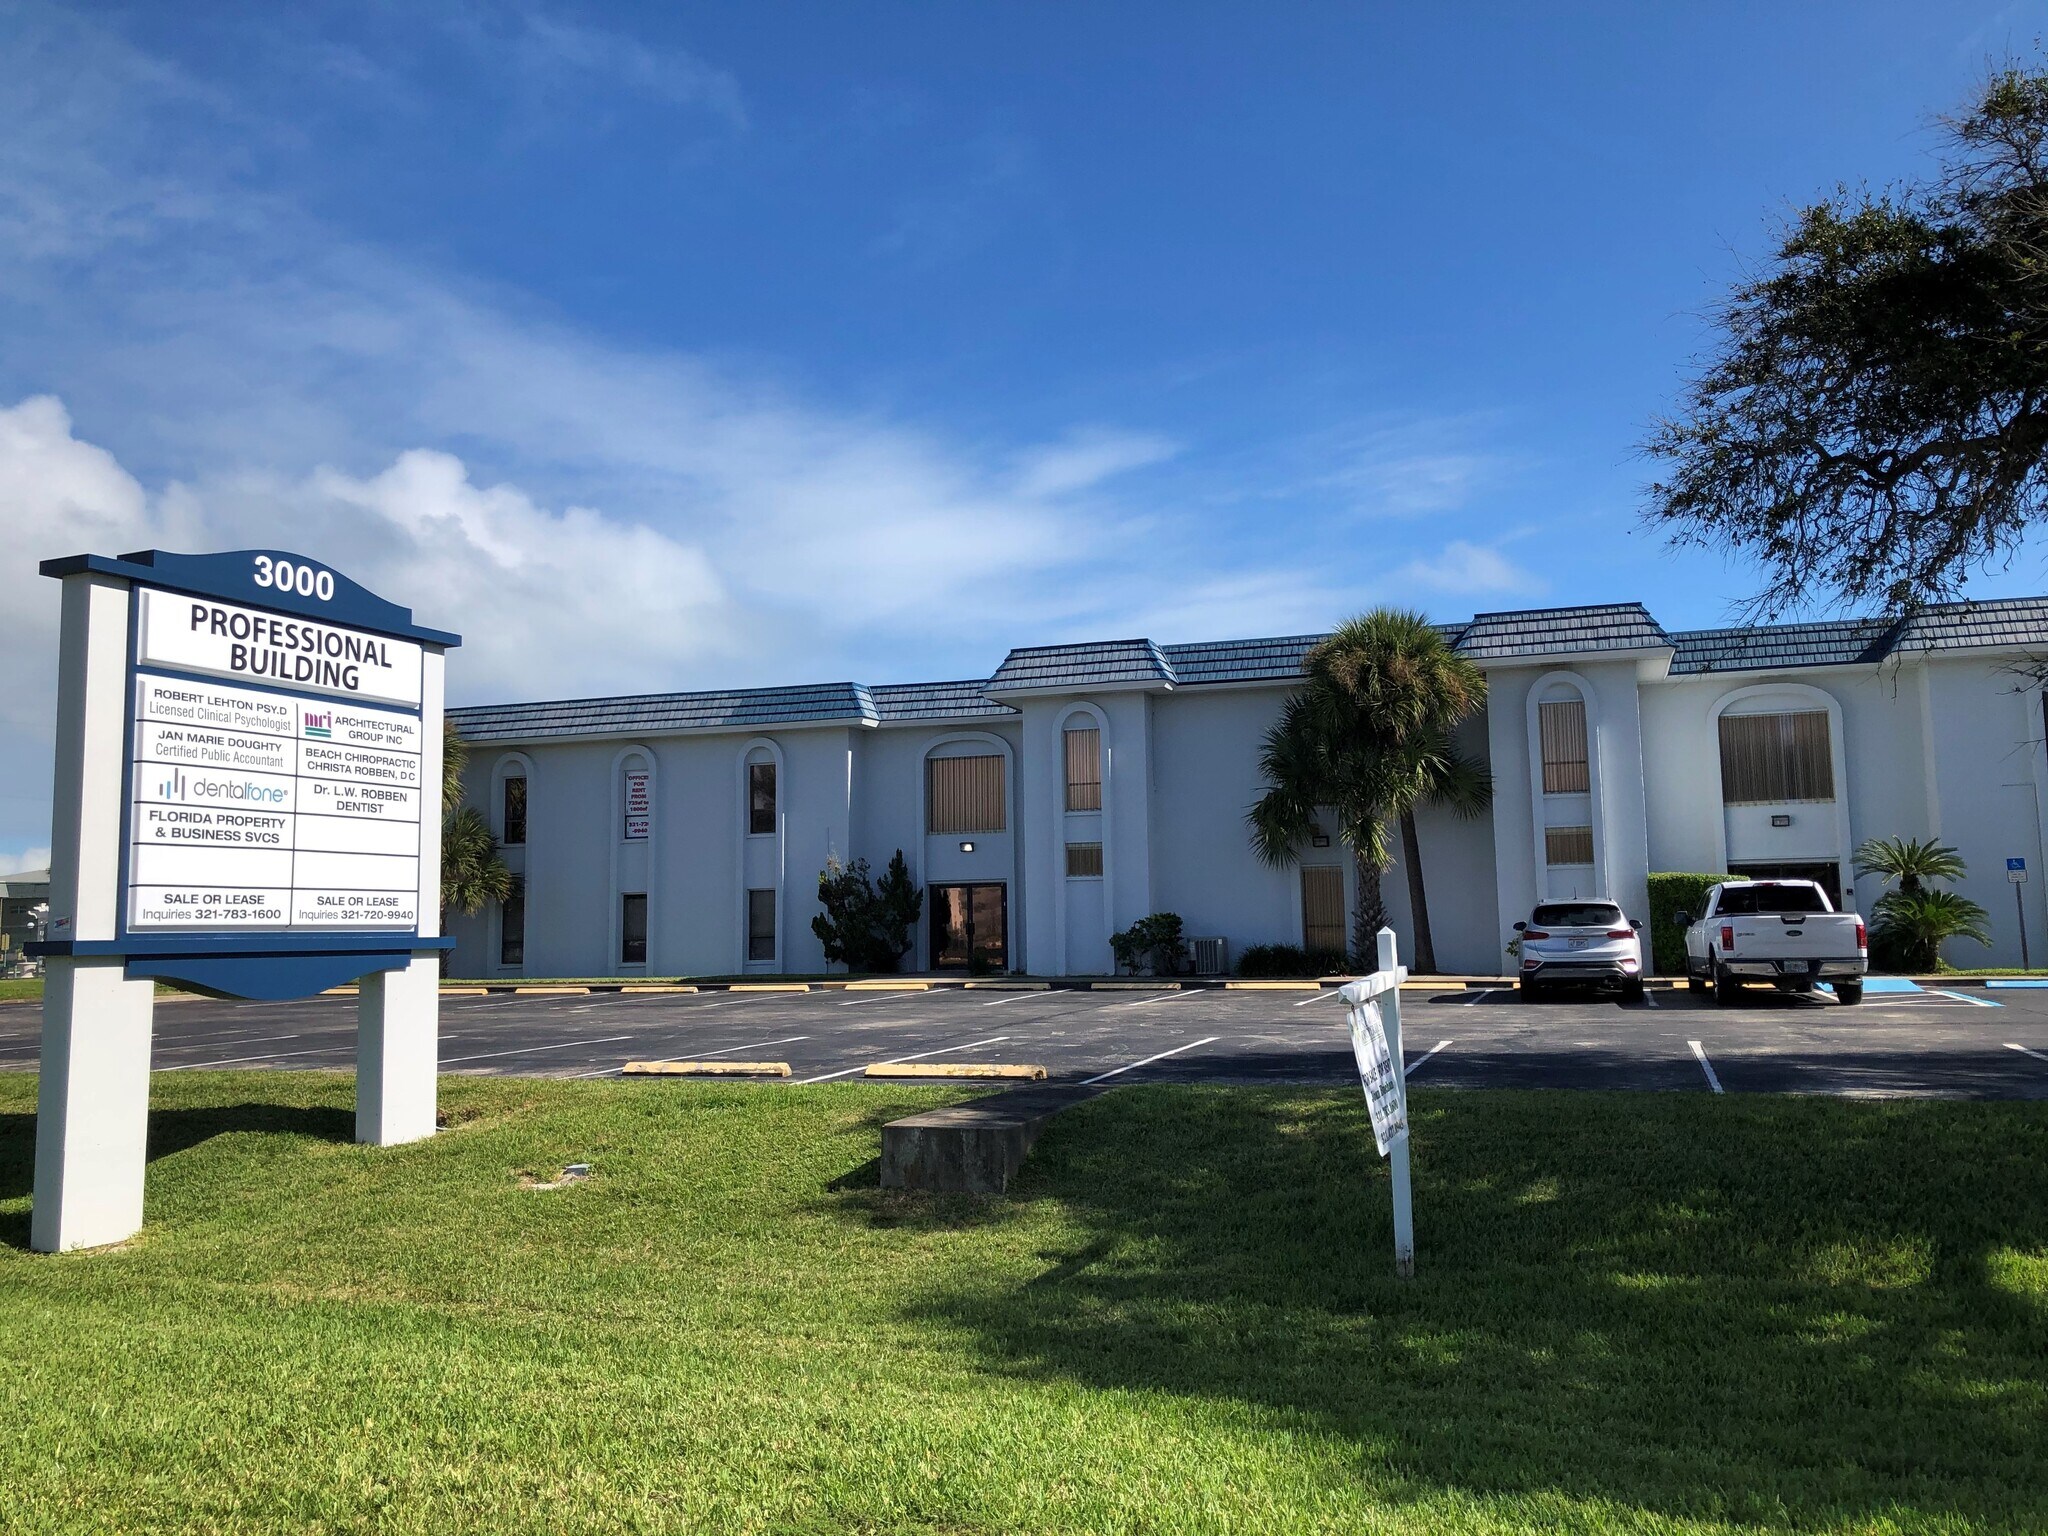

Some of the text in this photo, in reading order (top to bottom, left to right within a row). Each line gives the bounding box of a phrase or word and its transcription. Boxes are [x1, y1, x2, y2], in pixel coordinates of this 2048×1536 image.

[254, 556, 334, 601] 3000
[190, 604, 392, 668] PROFESSIONAL
[230, 644, 359, 690] BUILDING
[154, 689, 287, 715] ROBERT LEHTON PSY.D
[150, 702, 291, 731] Licensed Clinical Psychologist
[335, 717, 414, 734] ARCHITECTURAL
[158, 730, 282, 752] JAN MARIE DOUGHTY
[349, 730, 402, 744] GROUP INC
[156, 743, 283, 767] Certified Public Accountant
[306, 748, 415, 768] BEACH CHIROPRACTIC
[308, 761, 351, 774] CHRISTA
[355, 766, 397, 780] ROBBEN,
[314, 784, 407, 802] Dr. L.W. ROBBEN
[337, 801, 384, 813] DENTIST
[150, 810, 285, 828] FLORIDA PROPERTY
[156, 827, 279, 843] & BUSINESS SVCS
[164, 894, 265, 904] SALE OR LEASE
[317, 896, 399, 906] SALE OR LEASE
[143, 909, 281, 921] Inquiries 321-783-1600
[299, 910, 413, 921] Inquiries 321-720-9940
